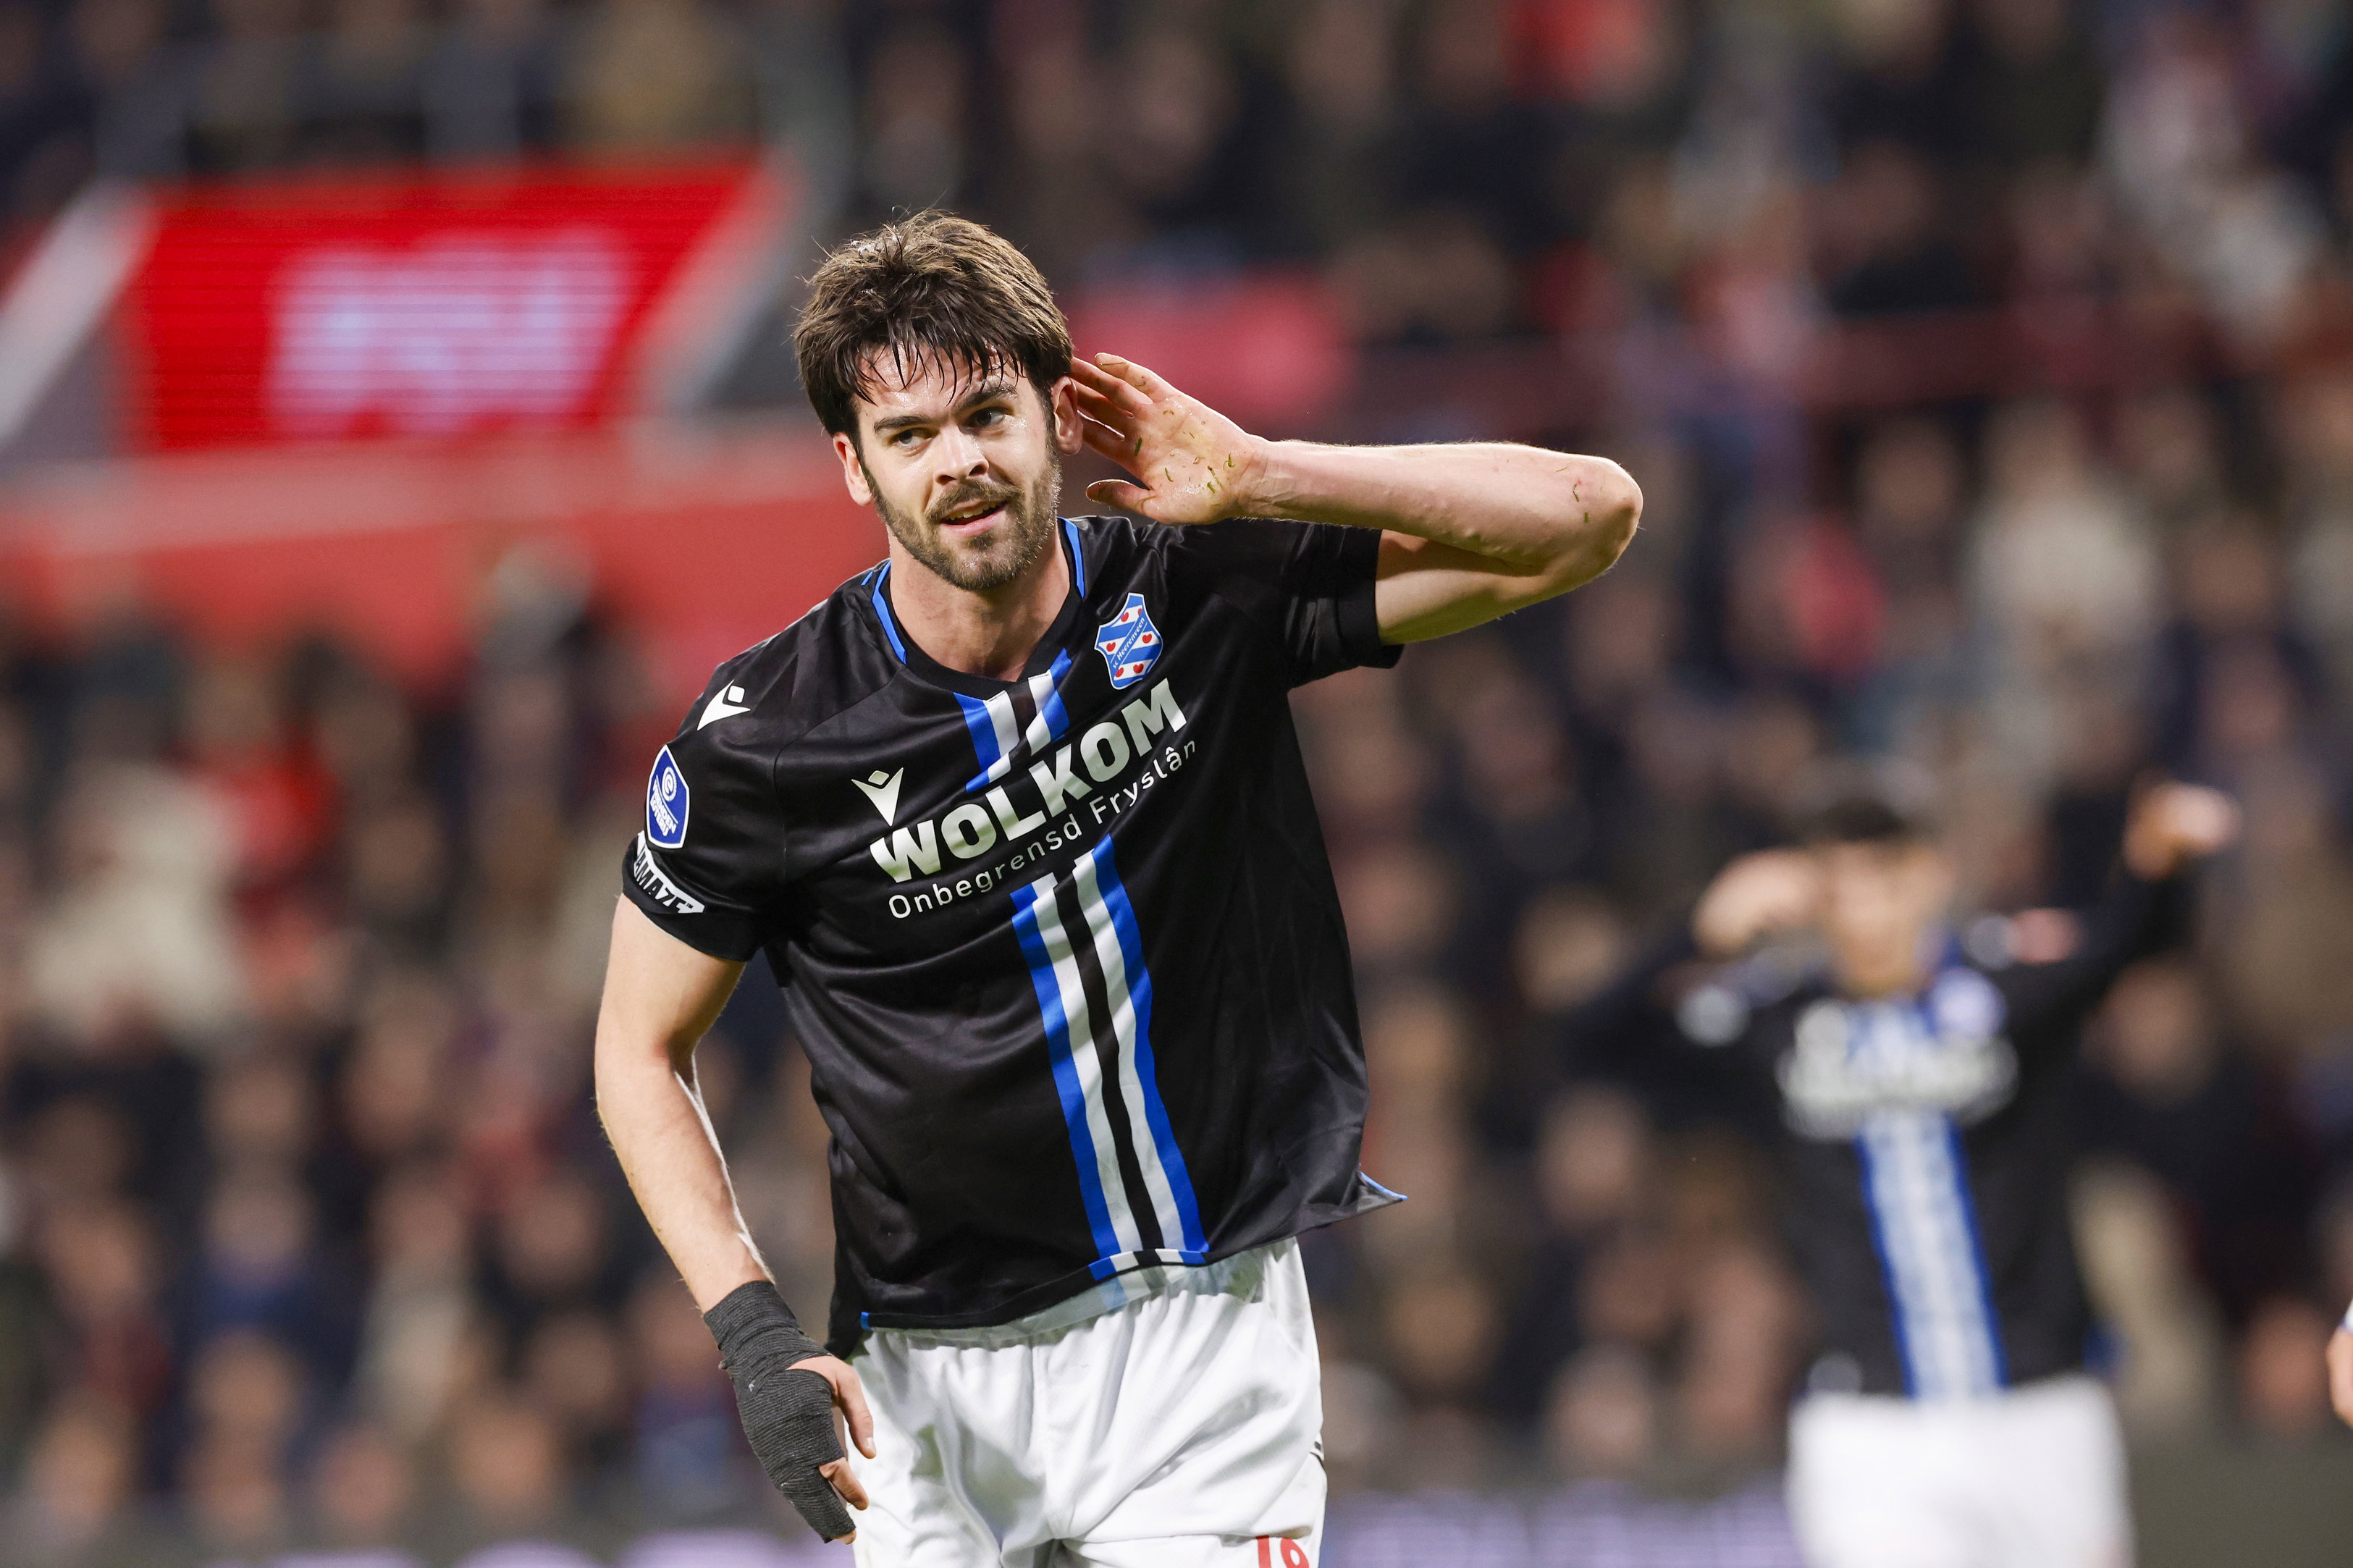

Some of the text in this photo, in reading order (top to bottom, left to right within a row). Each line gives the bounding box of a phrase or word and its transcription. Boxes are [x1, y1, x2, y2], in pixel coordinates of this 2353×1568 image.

[1116, 616, 1145, 661] Heerenveen
[870, 678, 1187, 883] WOLKOM
[888, 738, 1197, 919] Onbegrensd Fryslân
